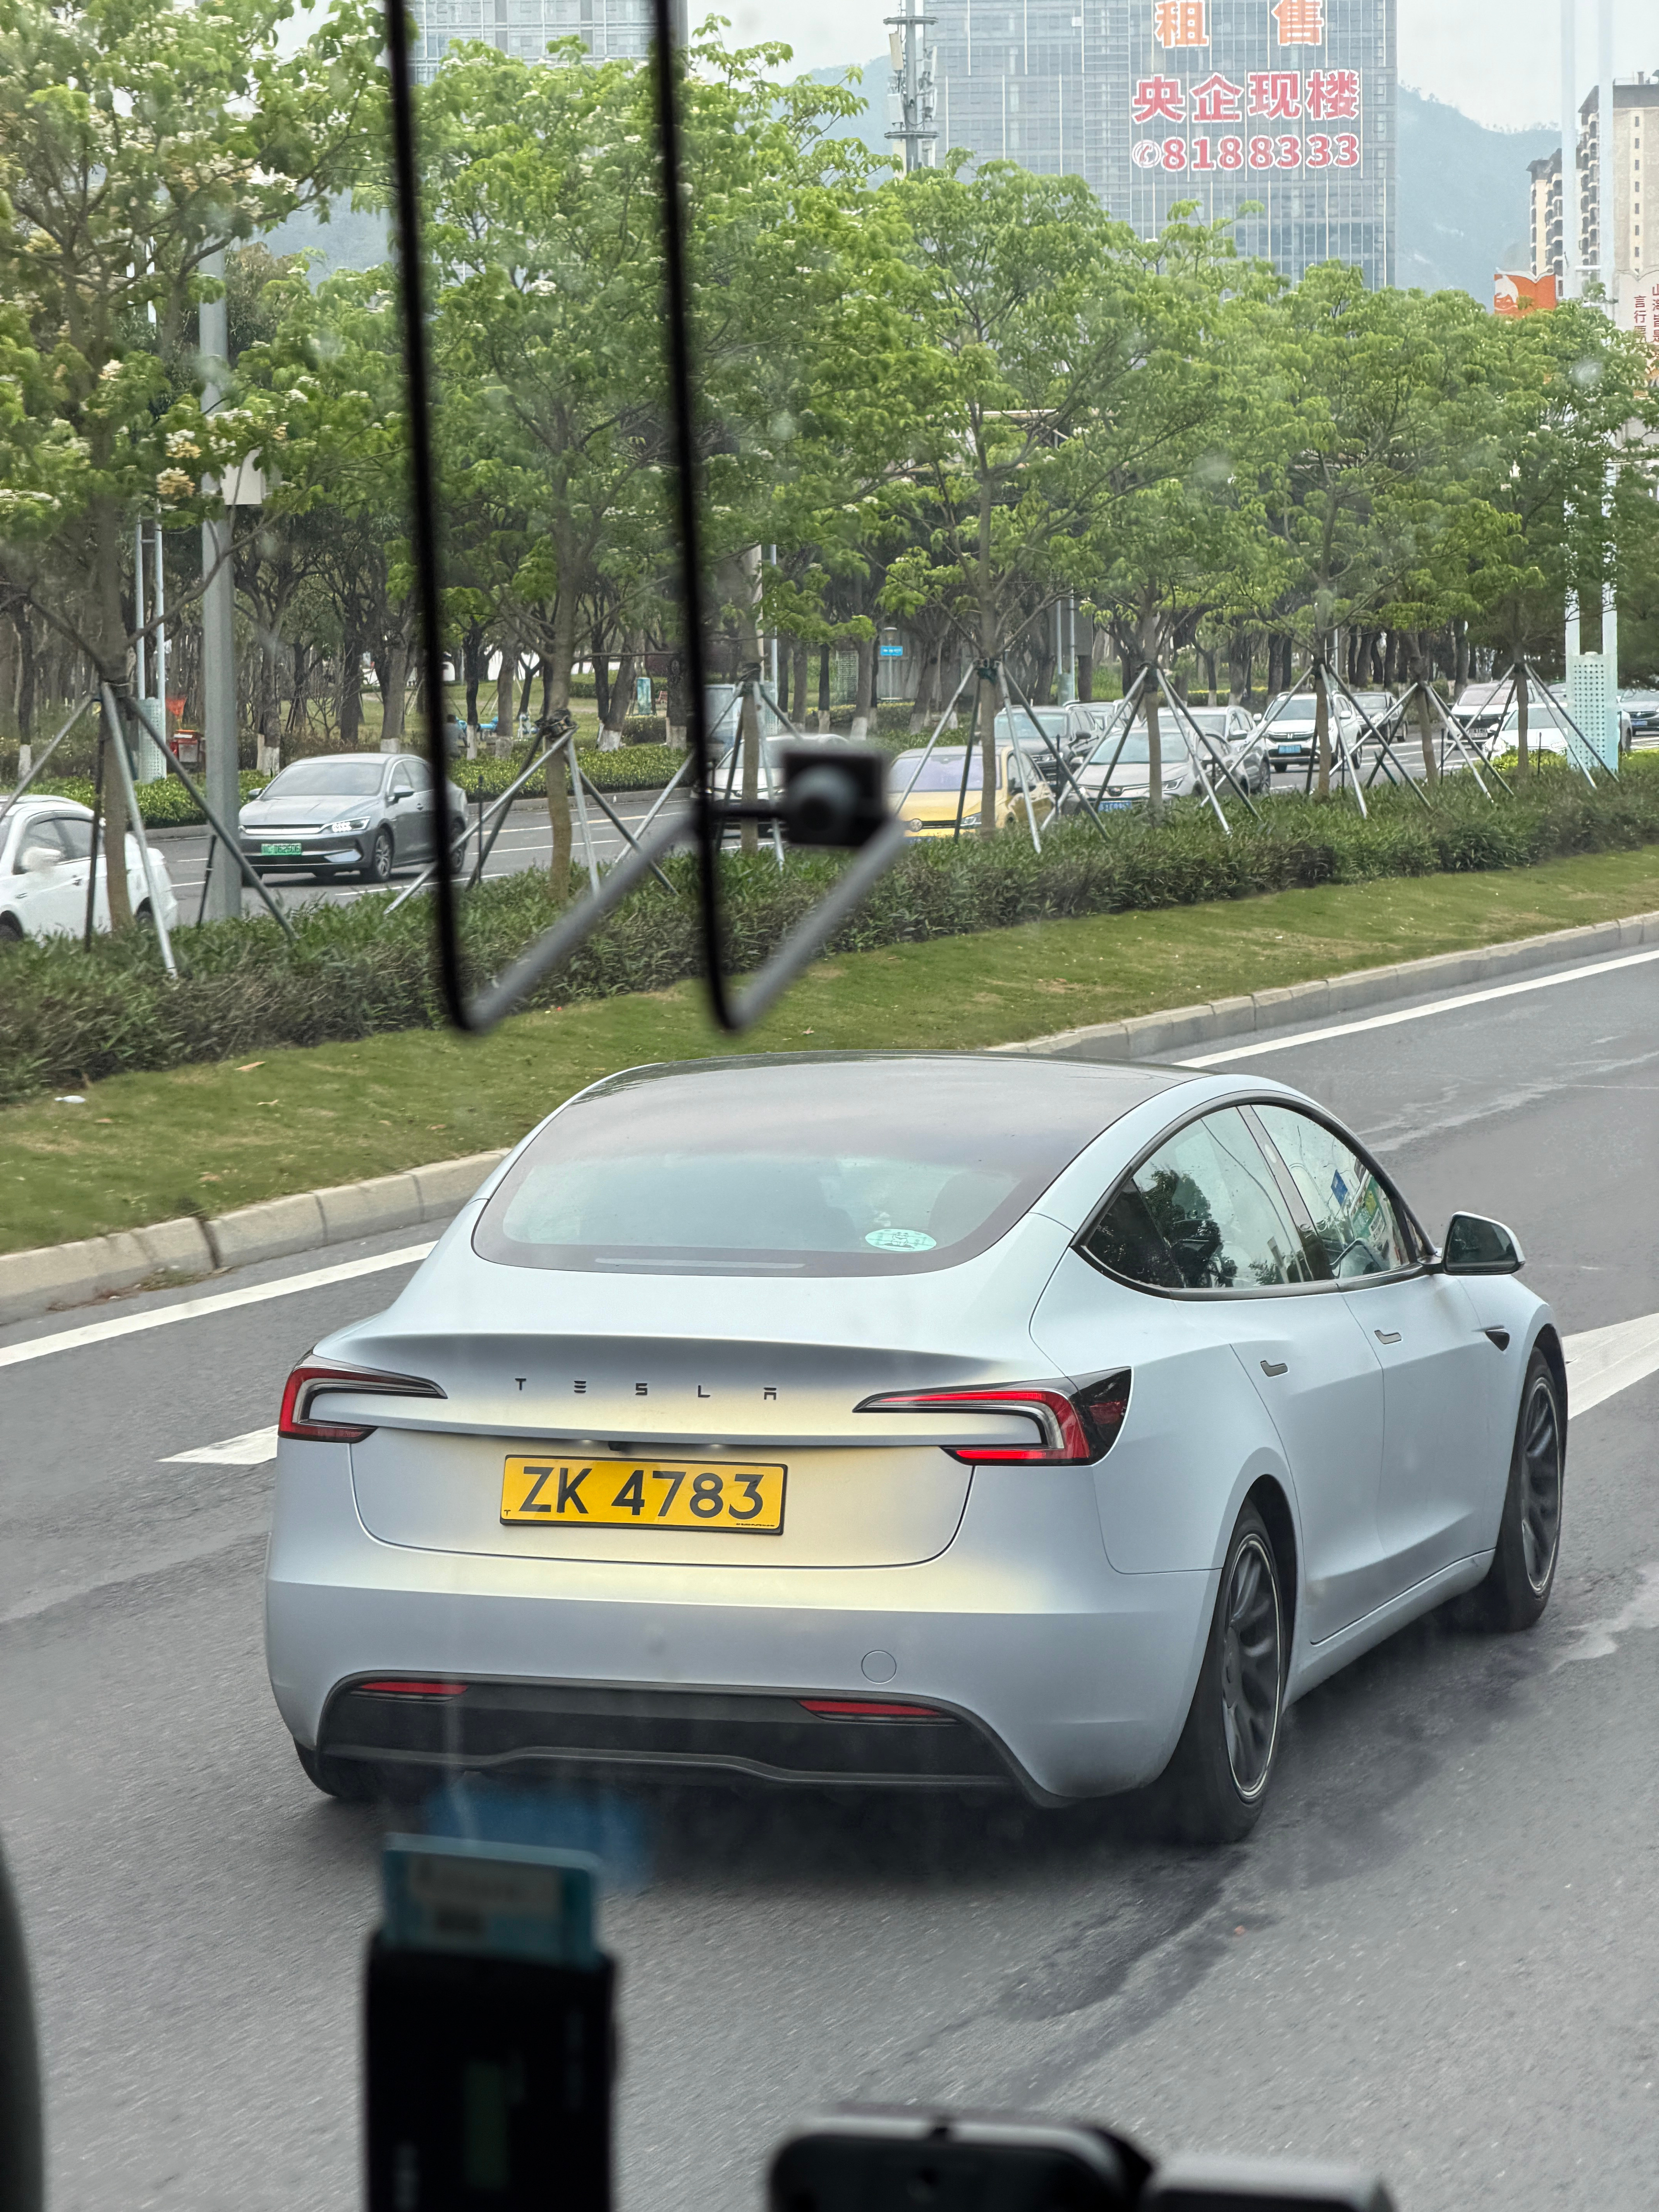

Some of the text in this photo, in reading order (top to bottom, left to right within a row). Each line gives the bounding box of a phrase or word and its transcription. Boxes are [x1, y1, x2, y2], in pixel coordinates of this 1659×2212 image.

[1132, 70, 1360, 124] 央企现楼
[1161, 134, 1359, 171] 8188333
[515, 1378, 777, 1400] TESLA
[518, 1466, 764, 1520] ZK 4783
